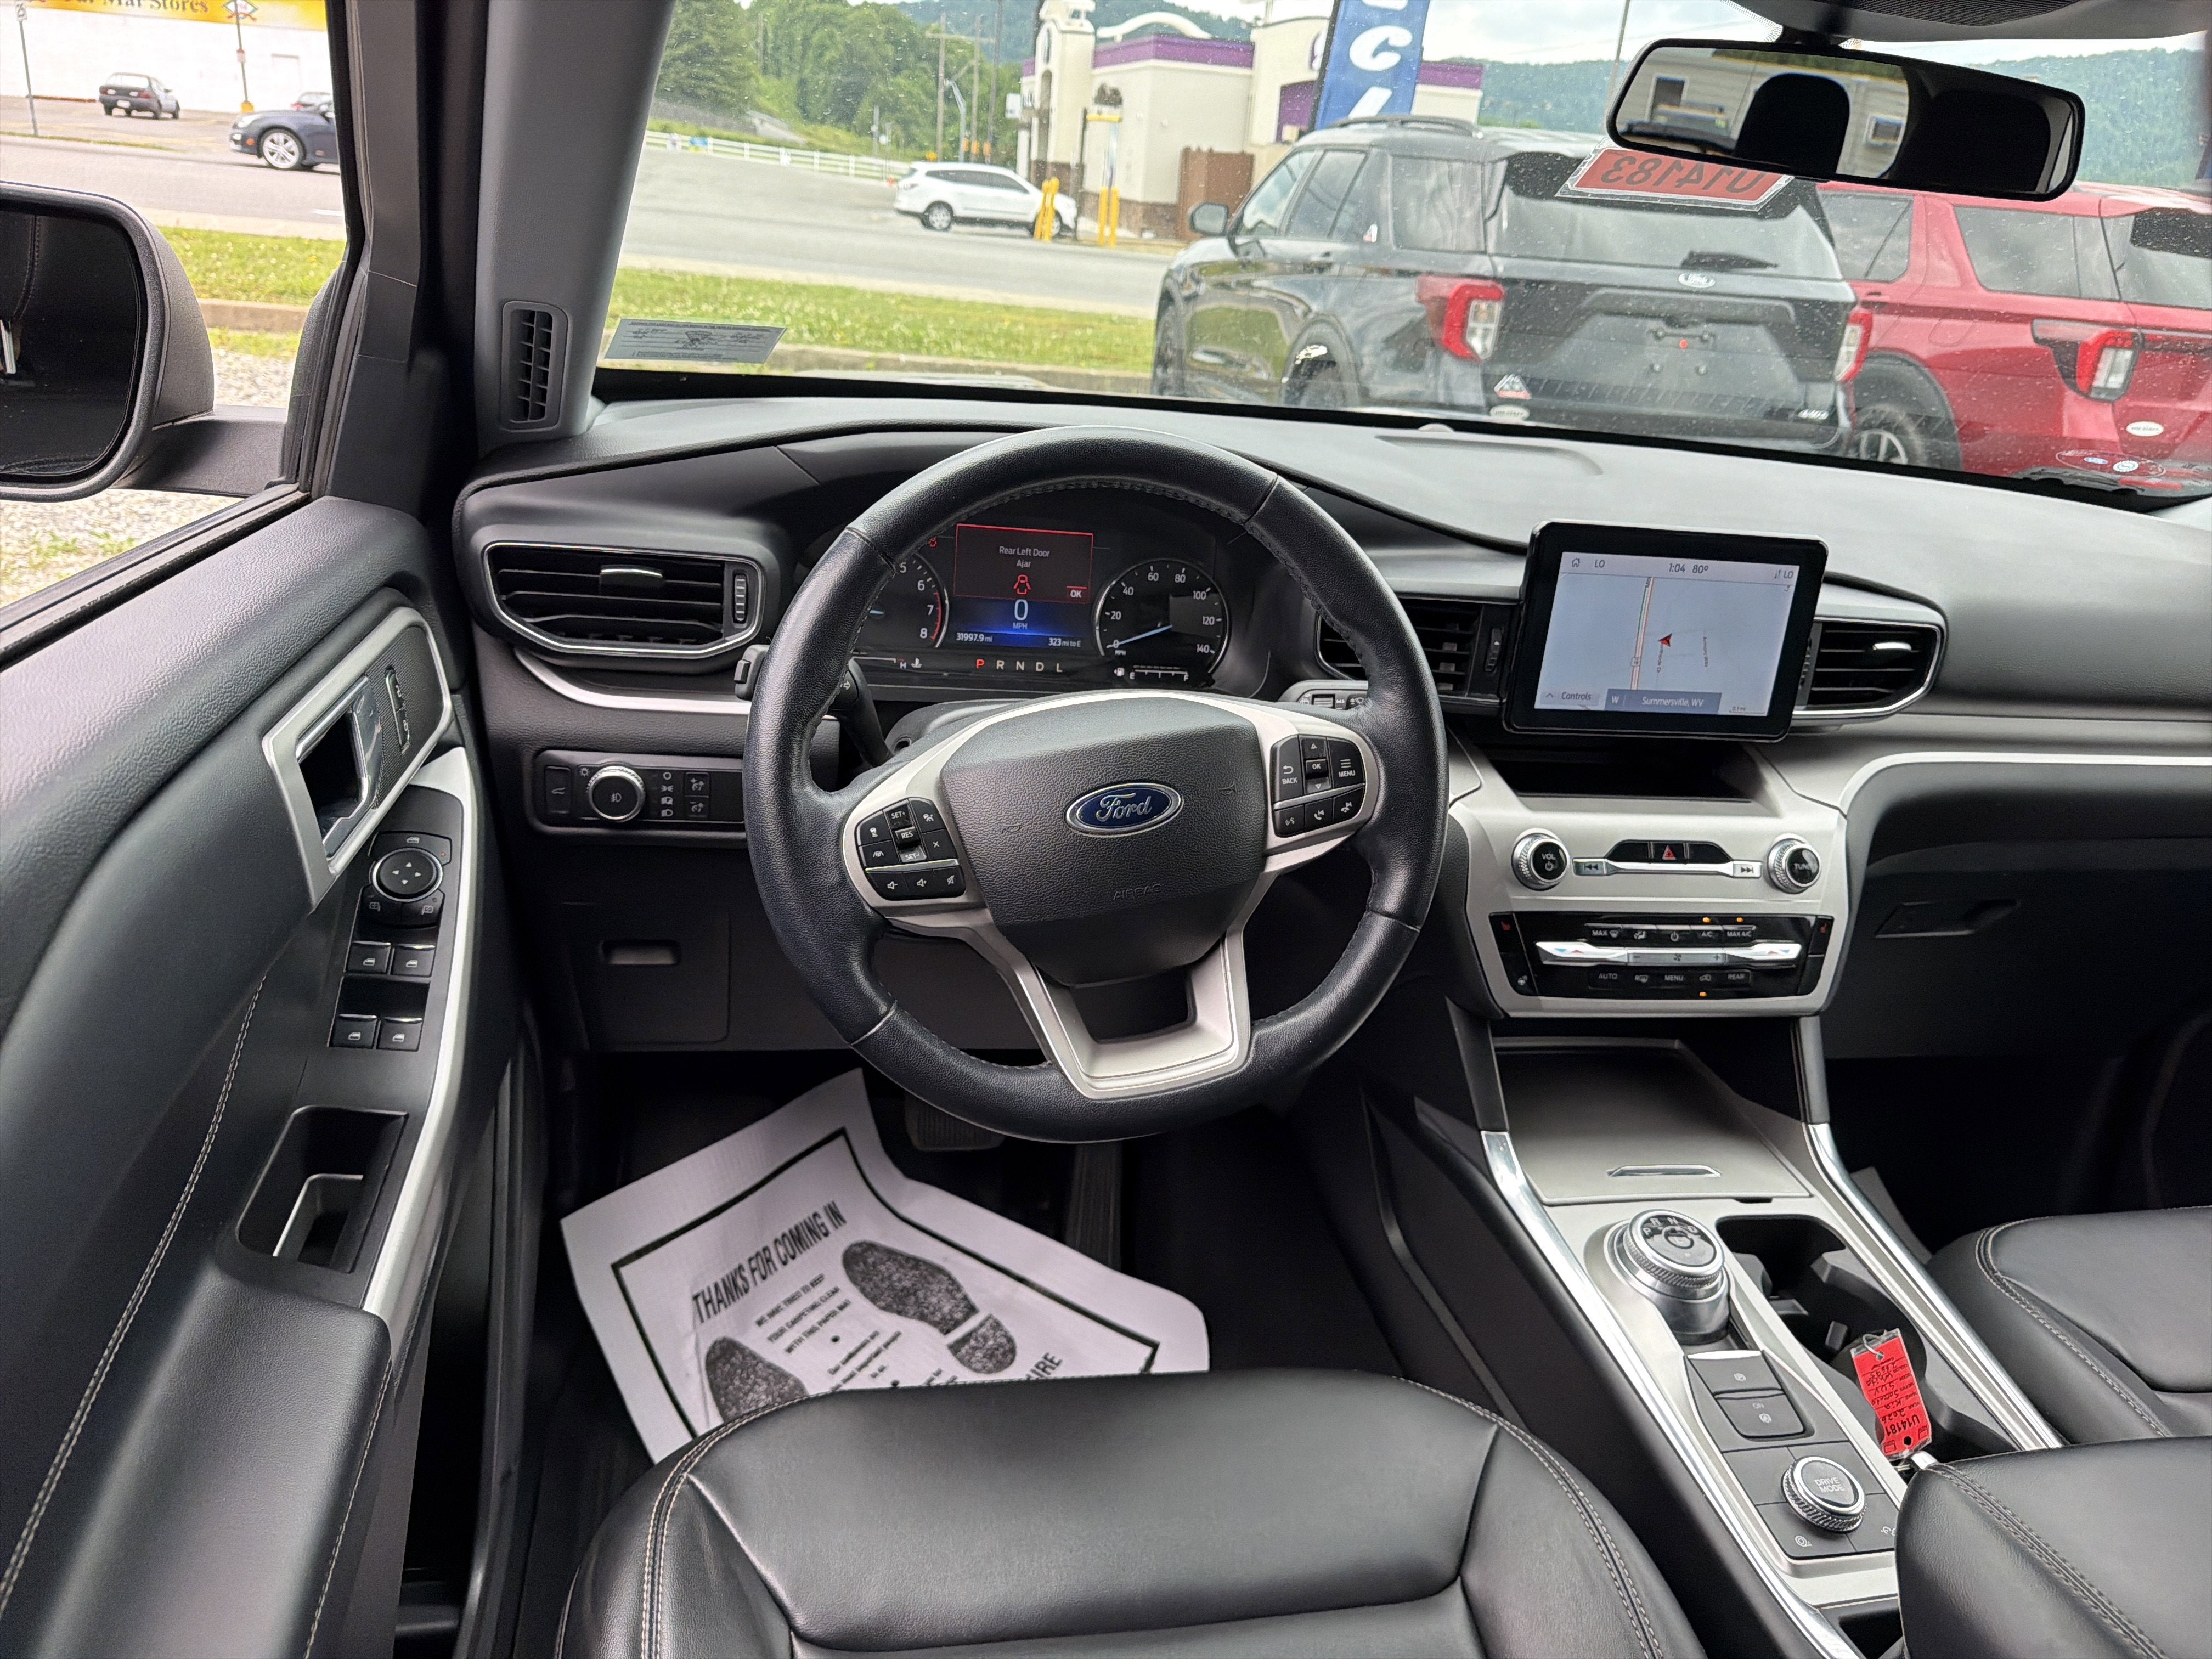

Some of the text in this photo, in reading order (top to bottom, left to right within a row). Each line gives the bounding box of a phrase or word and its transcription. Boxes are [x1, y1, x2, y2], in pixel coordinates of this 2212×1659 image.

[999, 546, 1049, 557] Rear Left Door
[899, 562, 907, 573] 5
[1017, 560, 1031, 568] Ajar
[1594, 560, 1605, 568] LO
[1669, 563, 1686, 573] 1:04
[1148, 572, 1159, 582] 60
[1175, 574, 1186, 583] 80
[1784, 570, 1795, 579] LO
[917, 580, 925, 591] 6
[1070, 589, 1082, 599] OK
[1122, 586, 1134, 596] 40
[1193, 591, 1206, 600] 100
[927, 605, 934, 616] 7
[1014, 599, 1028, 620] 0
[1110, 611, 1122, 620] 20
[1202, 616, 1215, 625] 120
[919, 628, 928, 639] 8
[956, 633, 984, 642] 31997.9
[1048, 637, 1062, 647] 323
[1113, 639, 1119, 648] 0
[1197, 644, 1210, 653] 140
[976, 659, 1063, 673] P R N D L
[1130, 672, 1135, 680] E
[1183, 673, 1189, 682] F
[1561, 691, 1592, 701] Controls
[1611, 696, 1704, 707] W Summersville, WV
[1096, 792, 1153, 822] Ford
[901, 831, 913, 839] RES
[1650, 1217, 1661, 1226] R
[1667, 1217, 1679, 1225] N
[1643, 1227, 1651, 1236] P
[1687, 1225, 1699, 1234] D
[691, 1199, 848, 1323] THANKS FOR COMING IN
[1874, 1380, 1895, 1396] SUV
[1884, 1414, 1920, 1436] U14181
[1814, 1477, 1840, 1486] DRIVE
[1818, 1485, 1844, 1493] MODE
